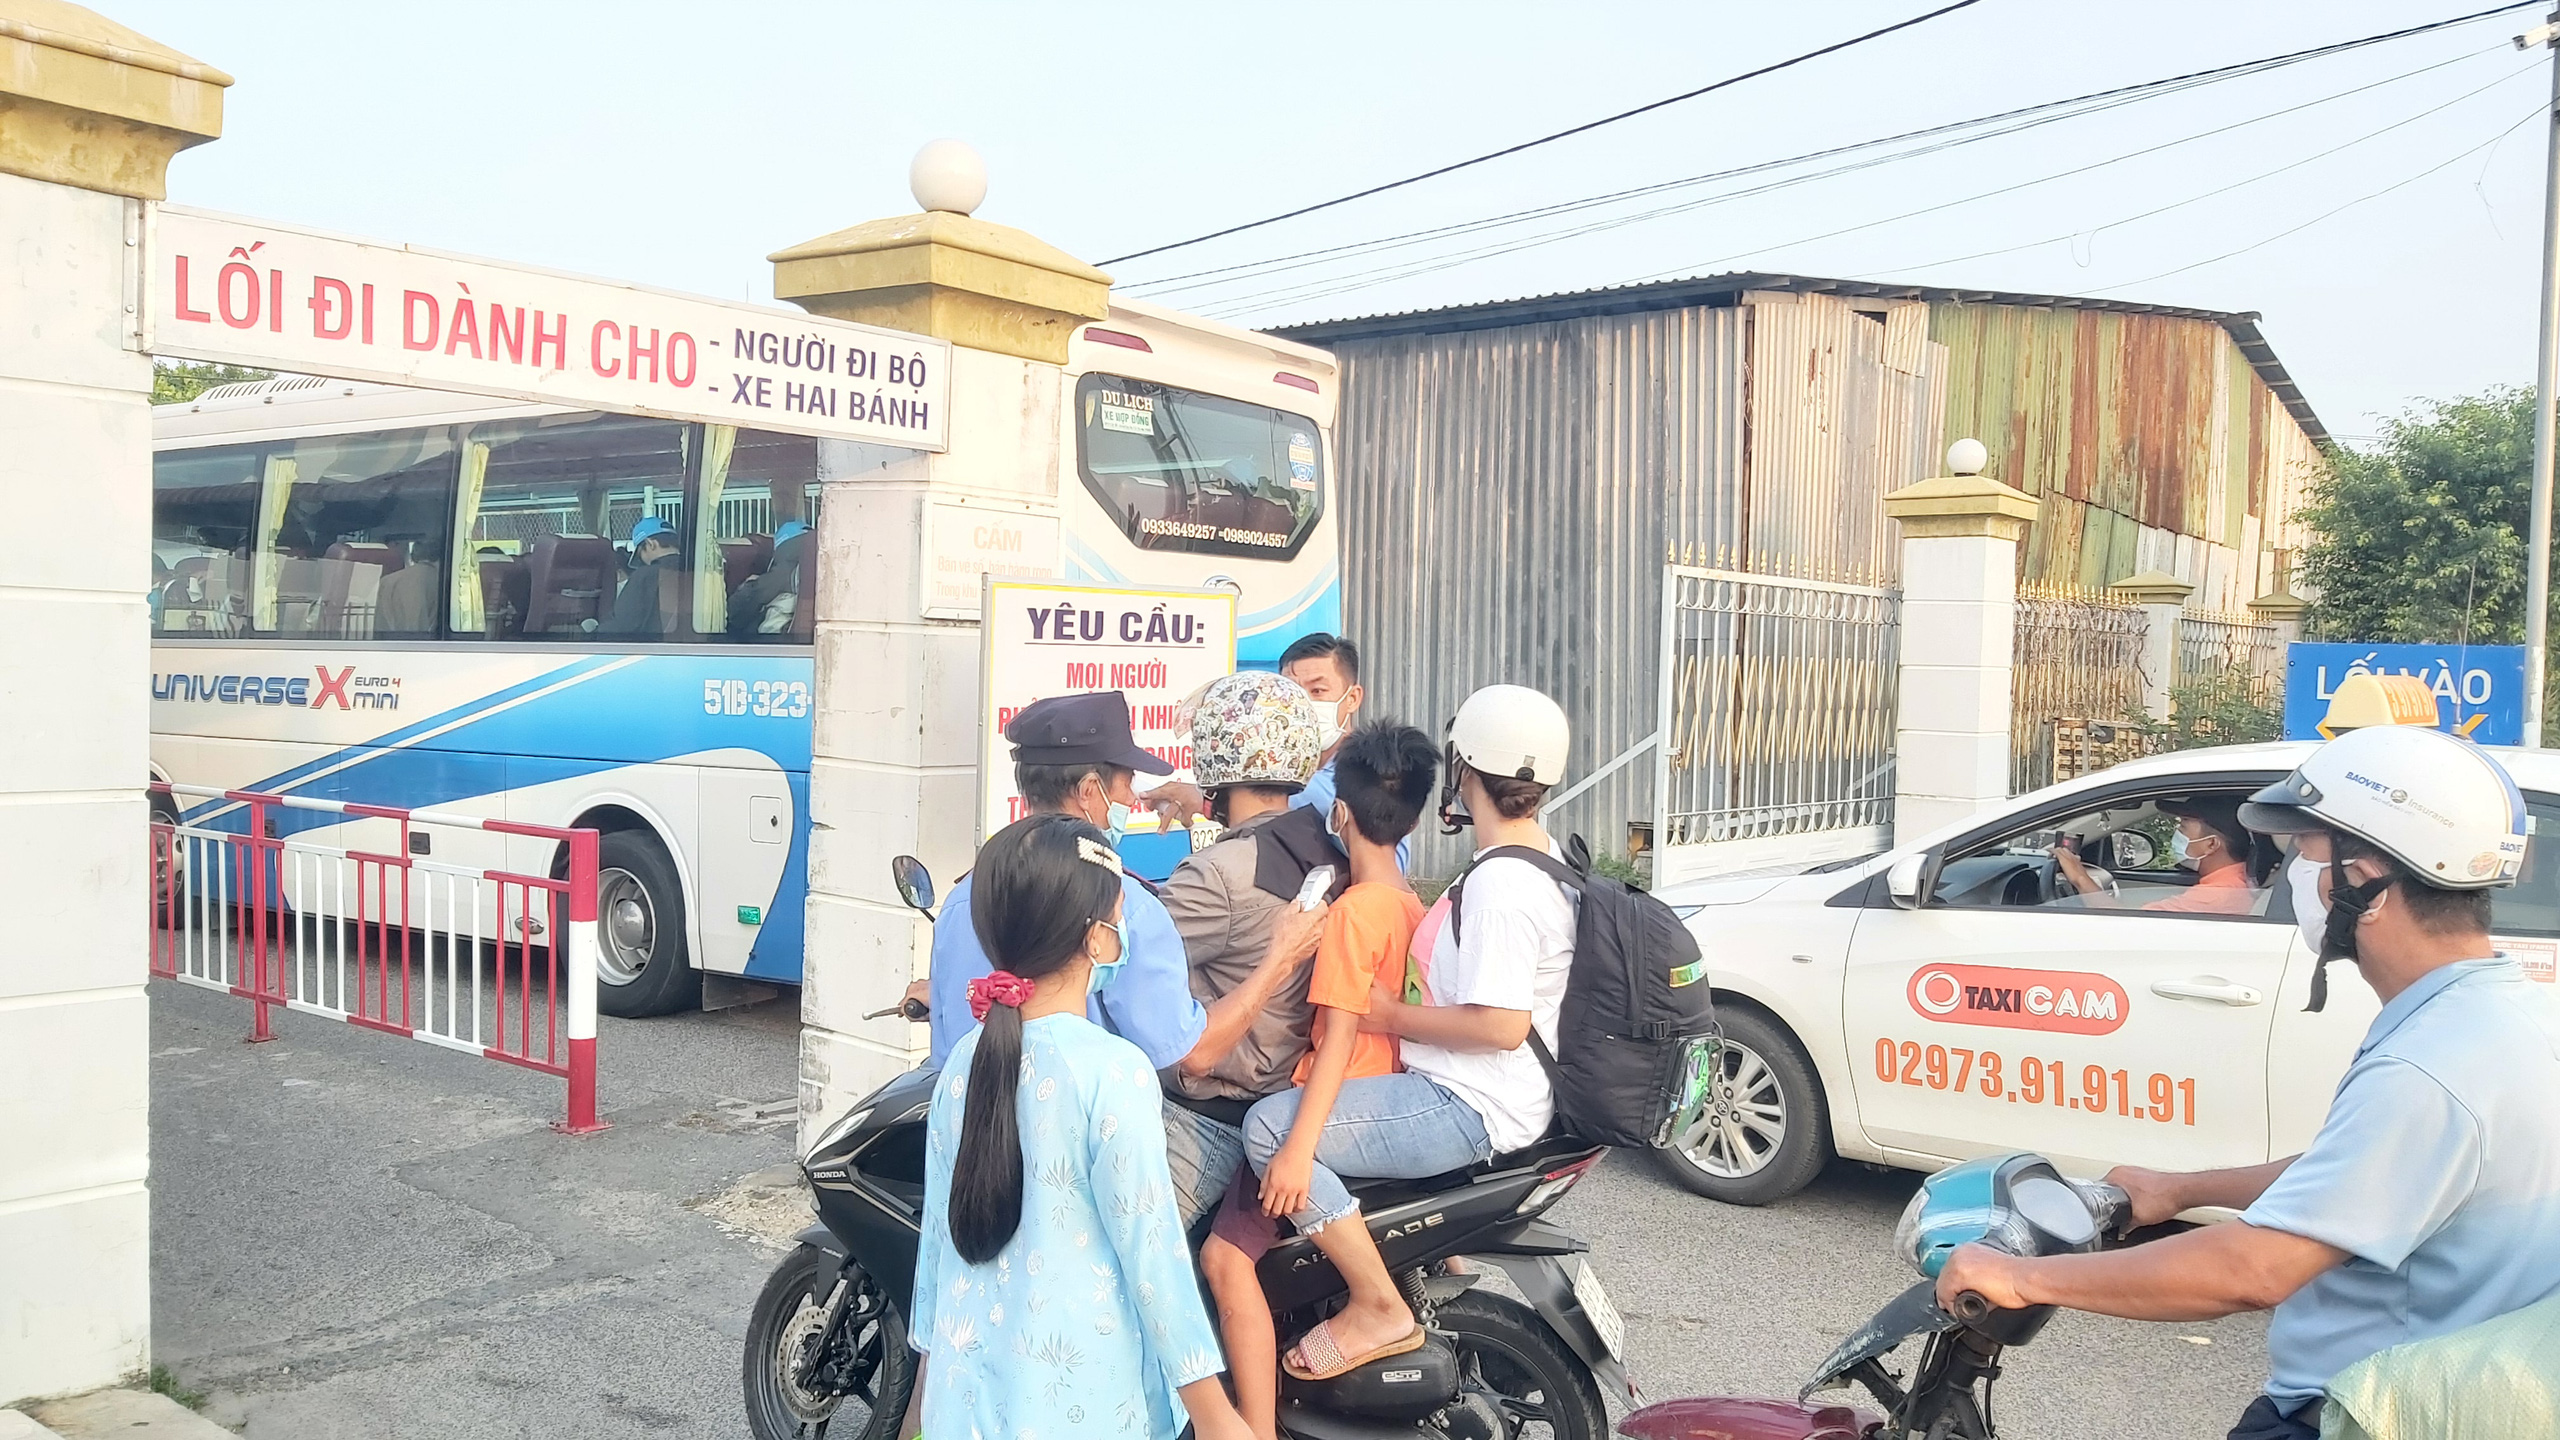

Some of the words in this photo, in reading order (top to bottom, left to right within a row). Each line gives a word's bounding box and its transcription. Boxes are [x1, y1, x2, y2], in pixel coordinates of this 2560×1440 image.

[175, 241, 282, 333] LỐI
[307, 275, 374, 345] ĐI
[403, 281, 568, 371] DÀNH
[590, 319, 697, 389] CHO
[734, 328, 835, 374] NGƯỜI
[846, 347, 876, 380] ĐI
[889, 351, 927, 394] BỘ
[731, 373, 773, 409] XE
[785, 381, 836, 418] HAI
[849, 387, 929, 431] BÁNH
[1101, 389, 1121, 406] DU
[1123, 393, 1154, 412] LỊCH
[972, 519, 1023, 553] CẤM
[1141, 517, 1217, 540] 0933649257
[1026, 602, 1105, 641] YÊU
[1119, 602, 1205, 644] CẦU:
[151, 673, 310, 706] UNIVERSE
[310, 664, 356, 711] X
[354, 676, 389, 688] EURO
[391, 677, 401, 689] 4
[1066, 662, 1104, 694] MỌI
[1110, 657, 1167, 689] NGƯỜI
[2344, 771, 2391, 794] BAOVIET
[2407, 798, 2455, 829] Insurance
[1965, 985, 2021, 1013] TAXI
[2024, 985, 2118, 1021] CAM
[1873, 1037, 2196, 1127] 02973.91.91.91
[812, 1170, 847, 1180] HONDA
